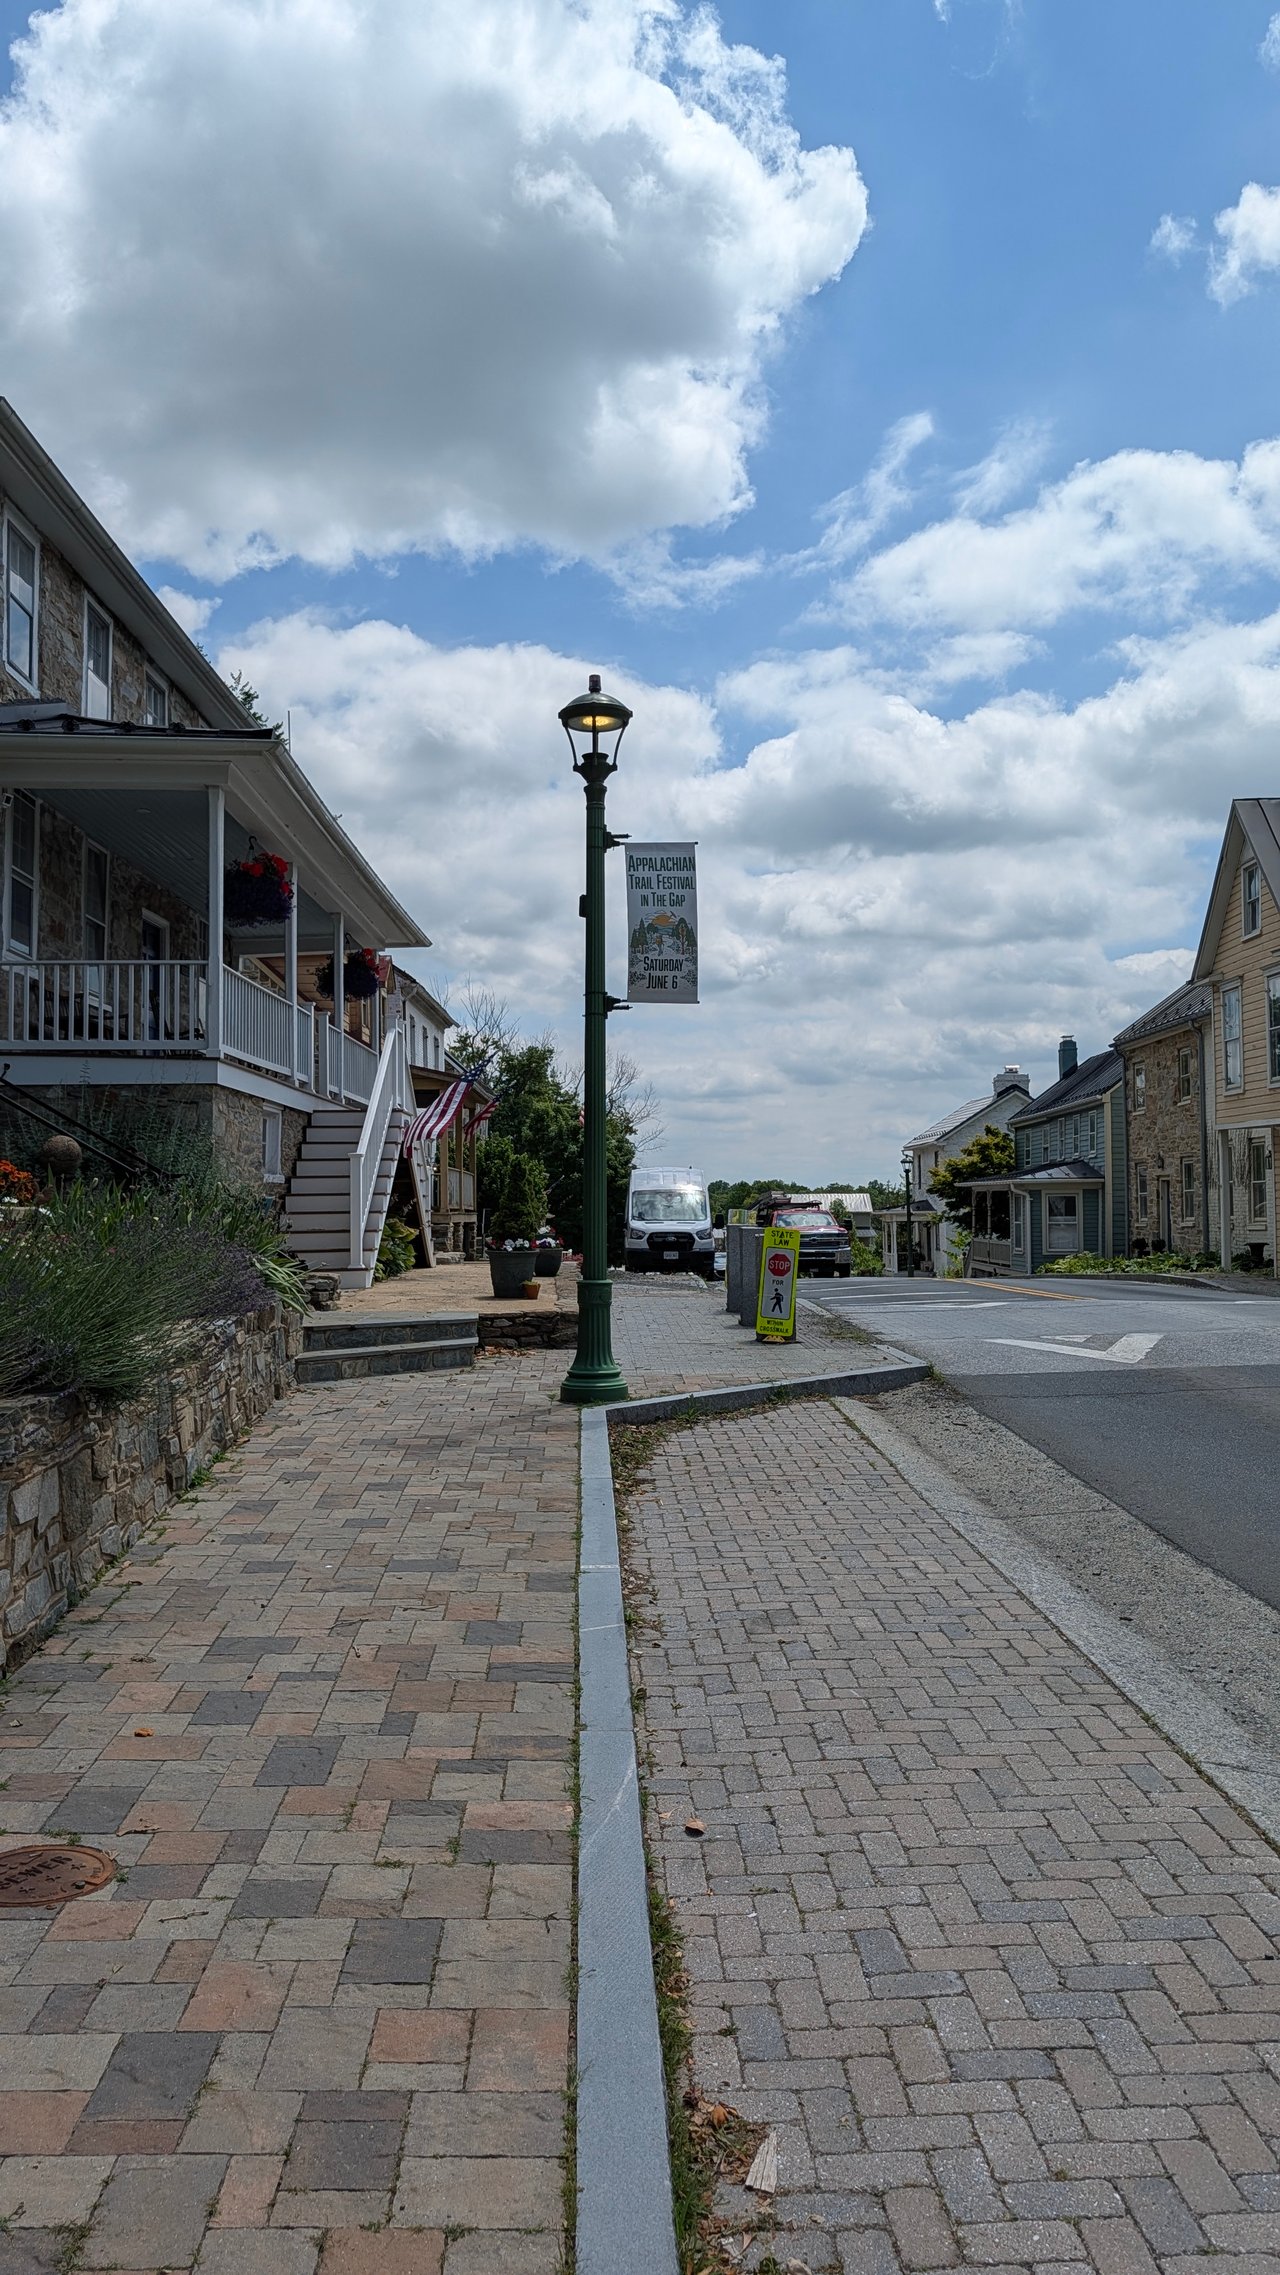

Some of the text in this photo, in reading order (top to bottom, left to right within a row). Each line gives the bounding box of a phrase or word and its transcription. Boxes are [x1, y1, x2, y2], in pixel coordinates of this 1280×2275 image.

[628, 855, 696, 872] APPALACHIAN
[628, 874, 696, 890] TRAIL FESTIVAL
[640, 892, 686, 907] IN THE GAP
[643, 956, 684, 972] SATURDAY
[646, 973, 678, 990] JUNE 6
[771, 1230, 795, 1239] STATE
[773, 1239, 790, 1247] LAW
[769, 1260, 791, 1271] STOP
